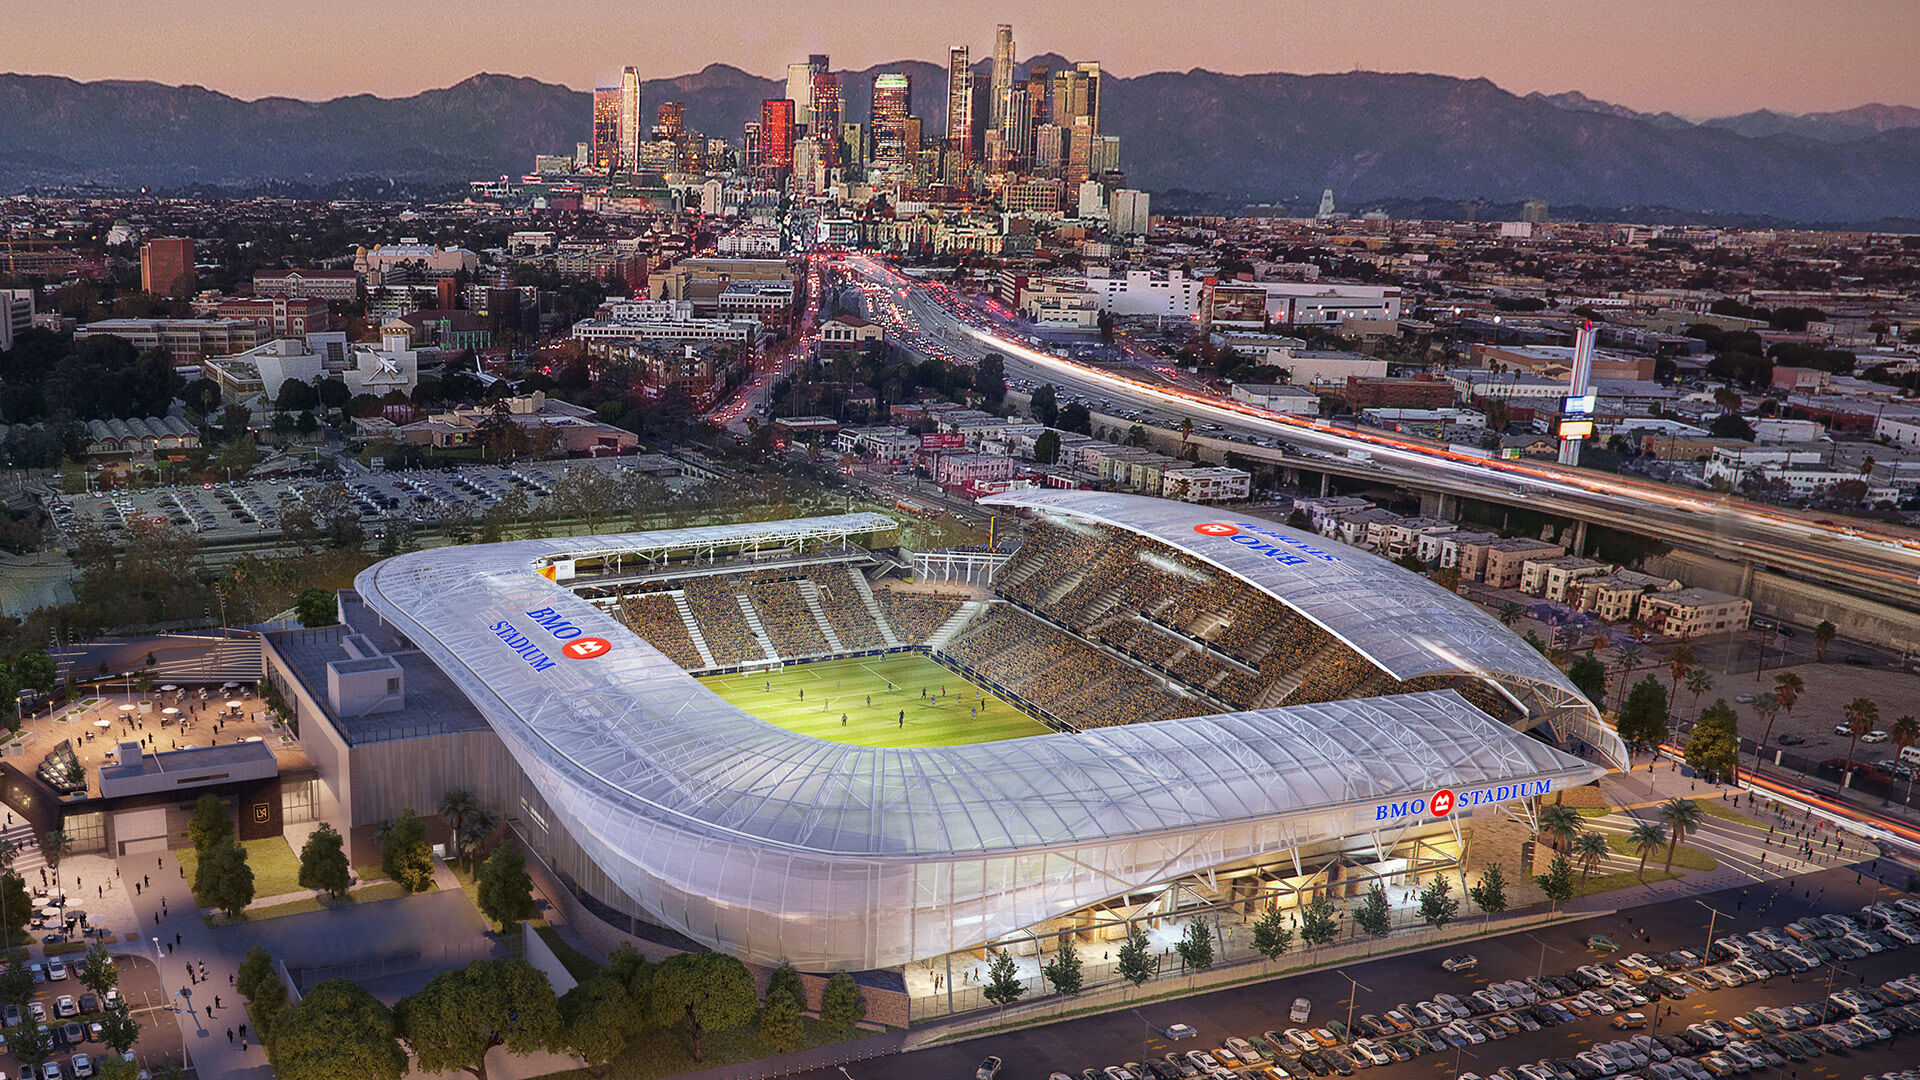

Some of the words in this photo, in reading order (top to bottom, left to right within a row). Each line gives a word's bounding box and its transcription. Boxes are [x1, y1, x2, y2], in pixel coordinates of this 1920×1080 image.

[1229, 535, 1311, 567] BMO
[1234, 522, 1342, 563] STADIUM
[525, 606, 583, 640] BMO
[489, 620, 557, 673] STADIUM
[1375, 798, 1426, 821] BMO
[1457, 778, 1553, 808] STADIUM
